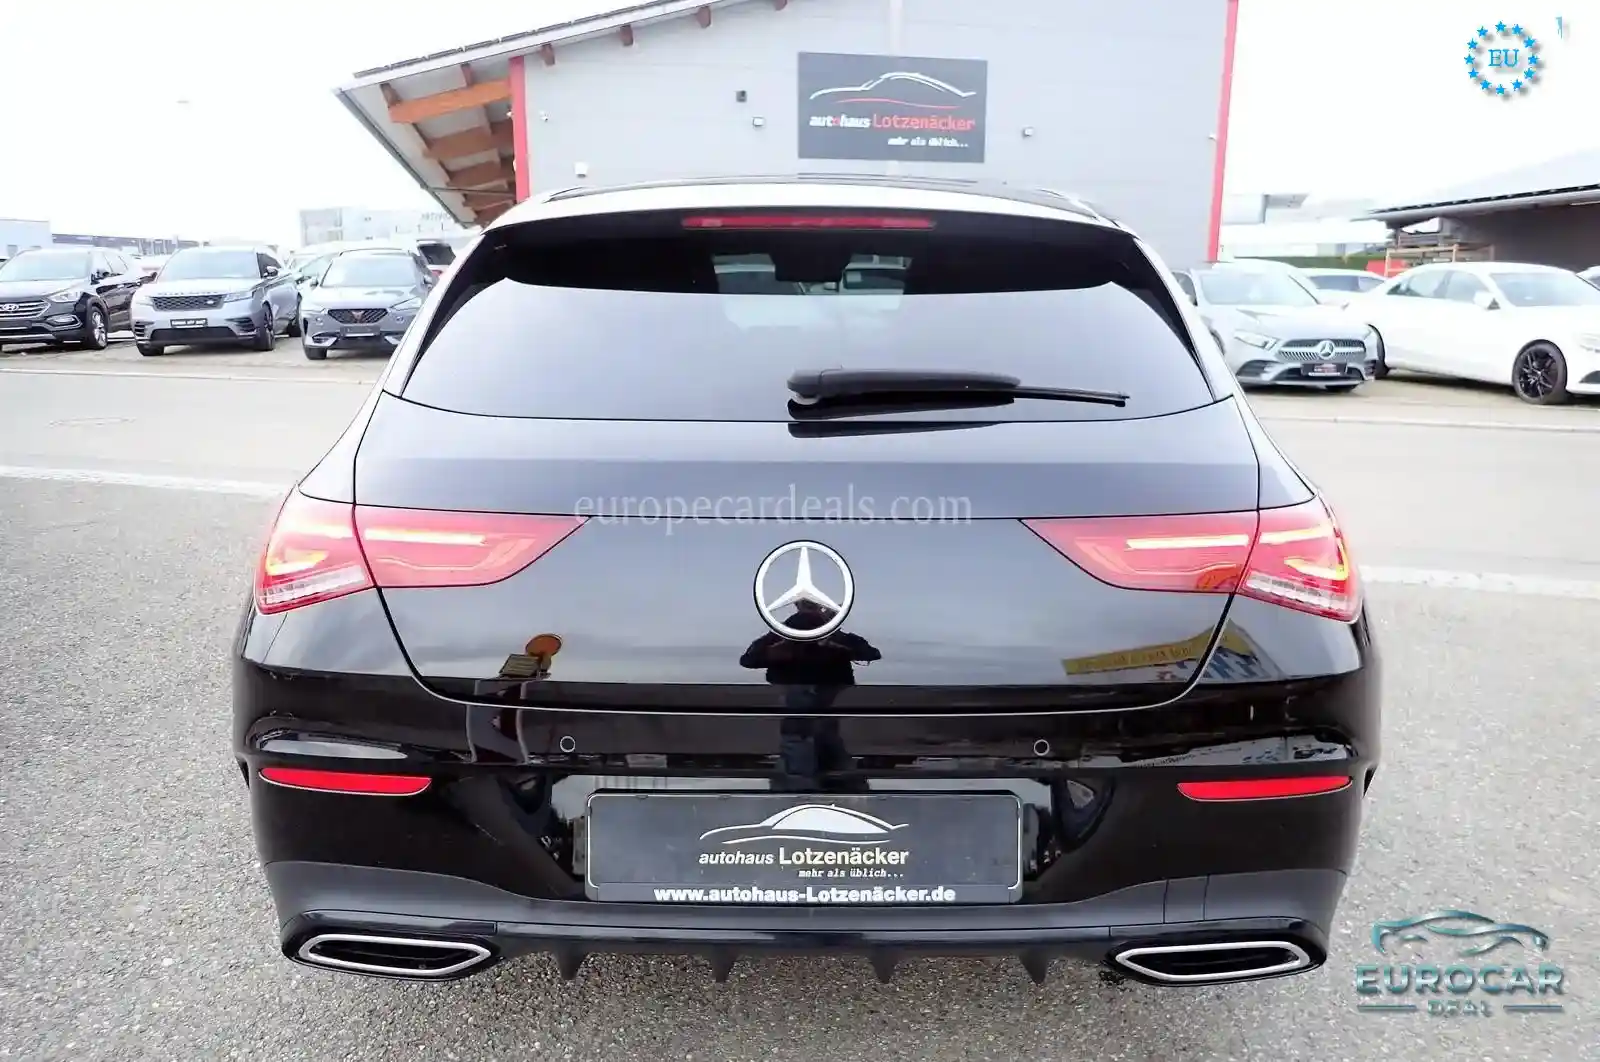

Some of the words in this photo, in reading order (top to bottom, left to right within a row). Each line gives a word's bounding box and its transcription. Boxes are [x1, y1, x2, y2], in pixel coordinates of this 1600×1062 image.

[809, 114, 871, 128] autohaus
[873, 113, 976, 131] Lotzenäcker
[699, 851, 775, 865] autohaus
[779, 847, 909, 865] Lotzenäcker
[798, 869, 824, 878] mehr
[827, 869, 845, 878] als
[654, 886, 956, 902] www.autohaus-Lotzenäcker.de
